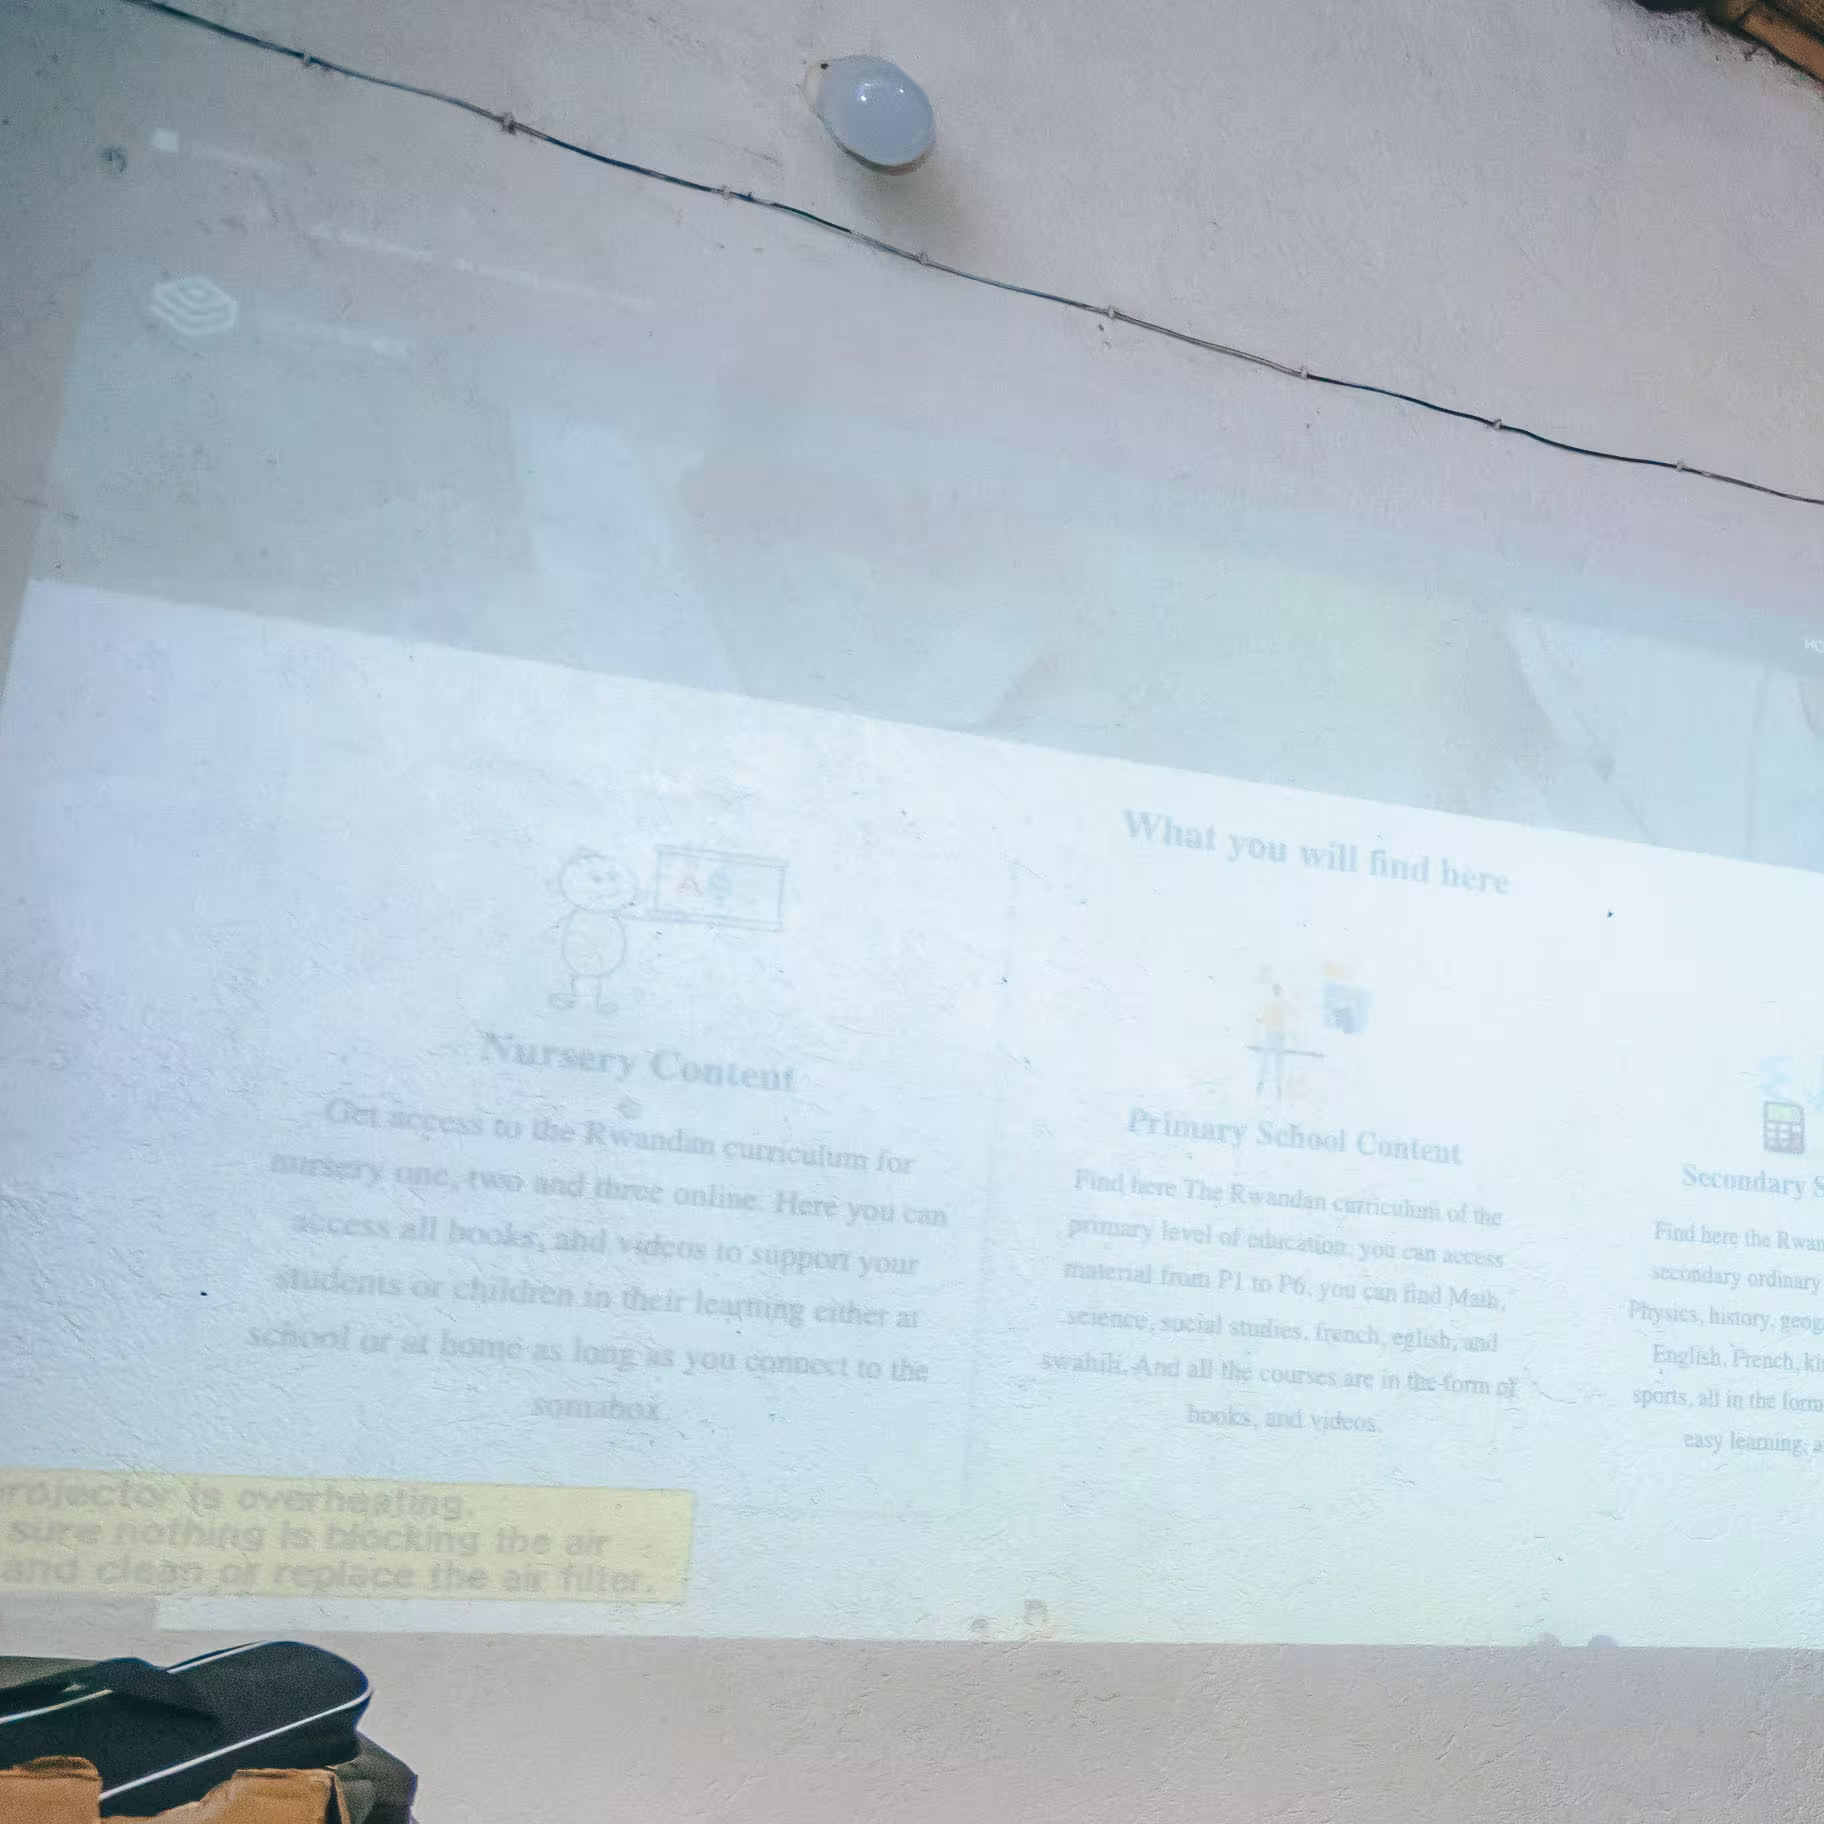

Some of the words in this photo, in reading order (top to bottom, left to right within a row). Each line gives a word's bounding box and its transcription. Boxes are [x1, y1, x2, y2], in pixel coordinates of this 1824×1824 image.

[1123, 809, 1216, 851] What
[1228, 835, 1288, 863] you
[1301, 841, 1358, 873] will
[1369, 848, 1430, 884] find
[1441, 857, 1510, 895] here
[484, 1035, 636, 1080] Nursery
[649, 1049, 796, 1092] Content
[1128, 1106, 1246, 1147] Primary
[1257, 1120, 1346, 1153] School
[1357, 1131, 1463, 1166] Content
[1075, 1167, 1124, 1195] Find
[1131, 1173, 1175, 1199] here
[1183, 1178, 1224, 1202] The
[1230, 1185, 1326, 1212] Rwandan
[1332, 1192, 1440, 1223] curriculum
[1448, 1201, 1468, 1223] of
[1473, 1205, 1503, 1228] the
[1682, 1160, 1805, 1198] Secondary
[1068, 1217, 1152, 1245] primary
[1161, 1221, 1211, 1246] level
[1220, 1228, 1239, 1249] of
[1357, 1240, 1396, 1263] you
[1402, 1245, 1436, 1264] can
[1442, 1249, 1505, 1269] access
[1654, 1221, 1694, 1243] Find
[1701, 1227, 1738, 1247] here
[1745, 1229, 1770, 1249] the
[1652, 1266, 1740, 1291] secondary
[1748, 1271, 1821, 1295] ordinary
[1699, 1389, 1720, 1409] all
[1727, 1391, 1744, 1410] in
[1750, 1391, 1776, 1411] the
[1782, 1394, 1824, 1414] form
[1684, 1434, 1723, 1455] easy
[0, 1479, 173, 1514] rojector
[326, 1521, 480, 1557] blocking
[494, 1523, 550, 1556] the
